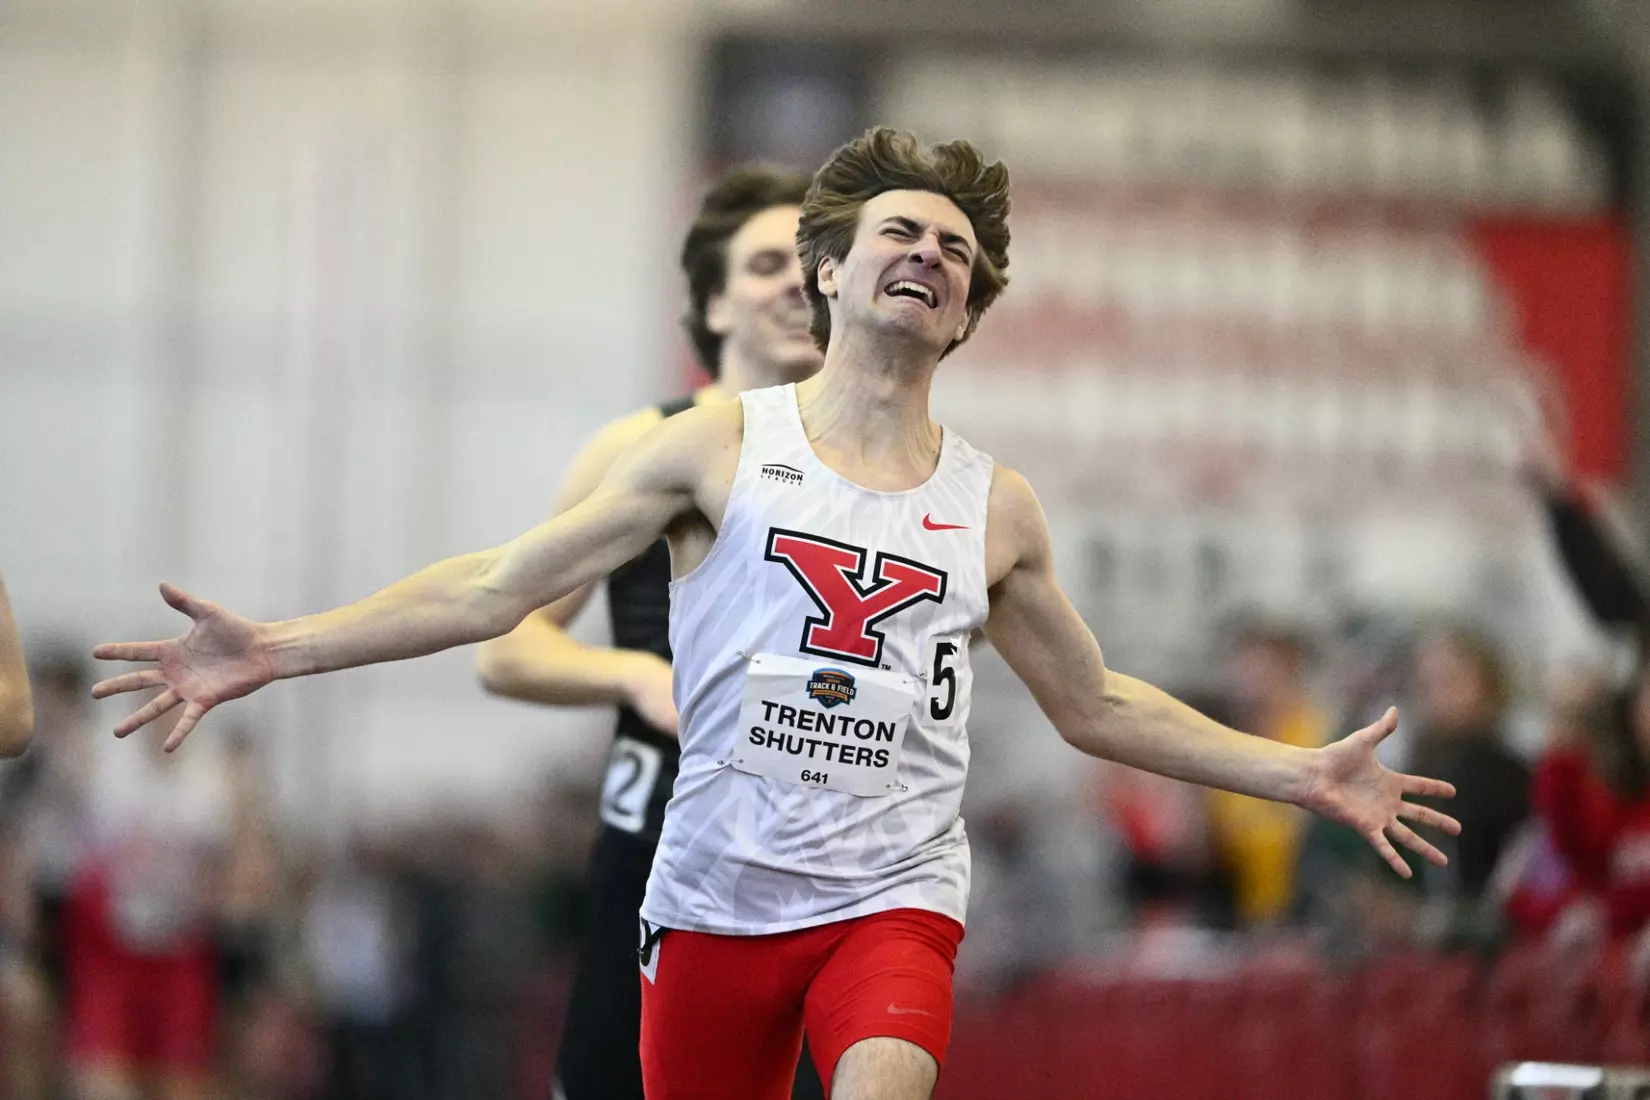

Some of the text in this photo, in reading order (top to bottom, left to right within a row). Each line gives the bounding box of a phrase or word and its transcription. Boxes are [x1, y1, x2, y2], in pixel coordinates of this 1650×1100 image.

[761, 475, 801, 485] LEAGUE
[762, 467, 803, 481] HORIZON
[764, 527, 948, 668] Y
[831, 683, 836, 691] &
[837, 685, 854, 696] FIELD
[930, 642, 958, 720] 5
[761, 700, 896, 742] TRENTON
[749, 727, 889, 768] SHUTTERS
[613, 751, 642, 817] 2
[800, 769, 829, 784] 641
